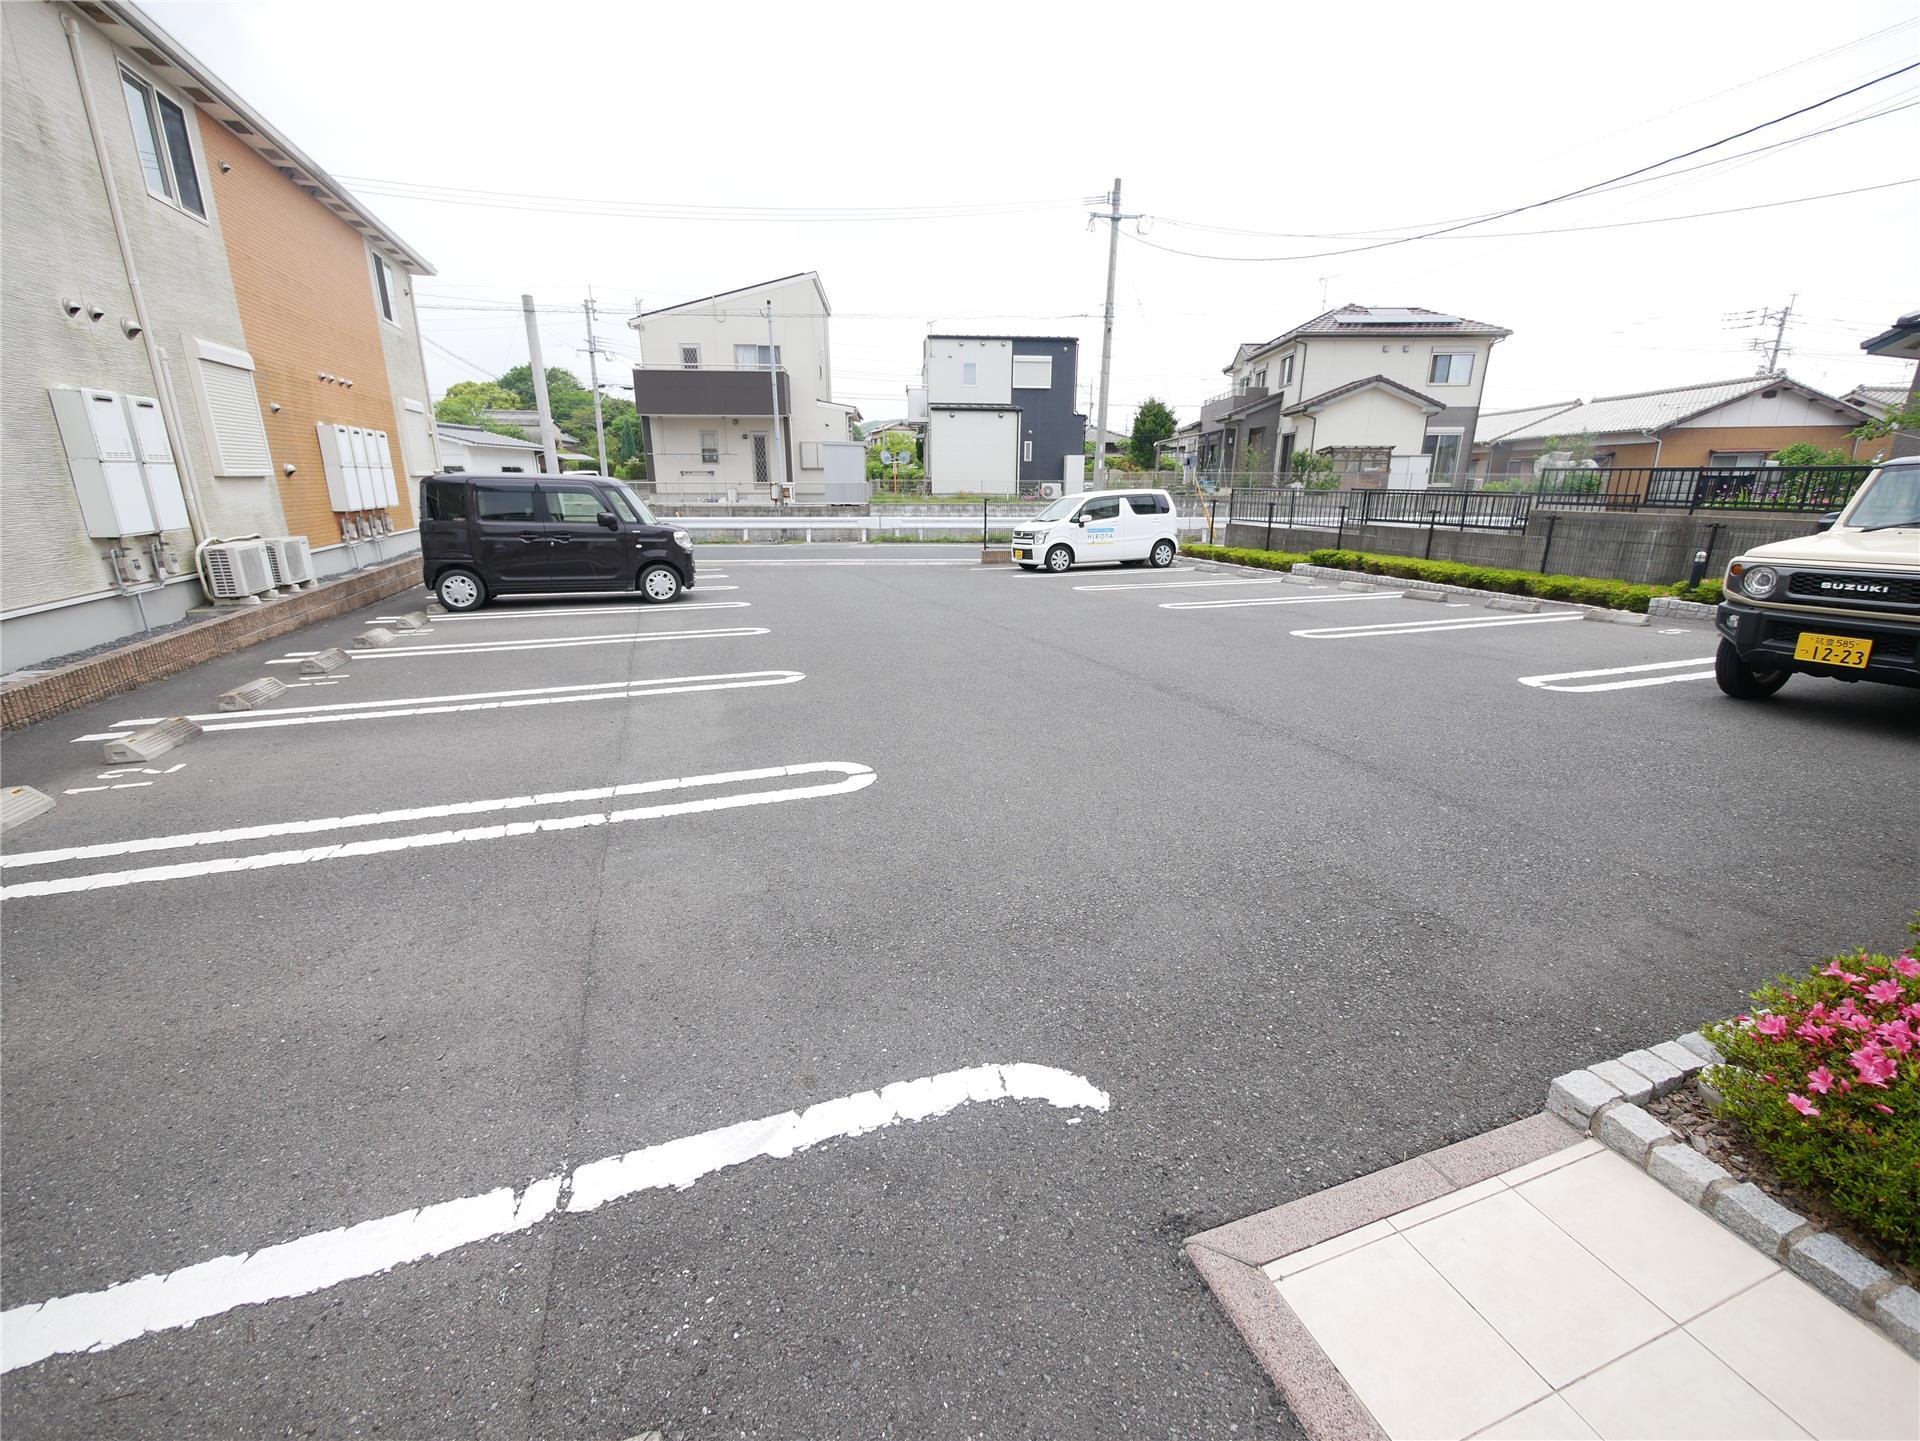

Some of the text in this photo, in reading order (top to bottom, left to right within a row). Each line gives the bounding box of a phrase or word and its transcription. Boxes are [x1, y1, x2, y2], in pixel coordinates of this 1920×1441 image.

[1820, 581, 1889, 593] SUZUKI
[1836, 639, 1855, 648] 585
[1812, 646, 1864, 664] 12-23
